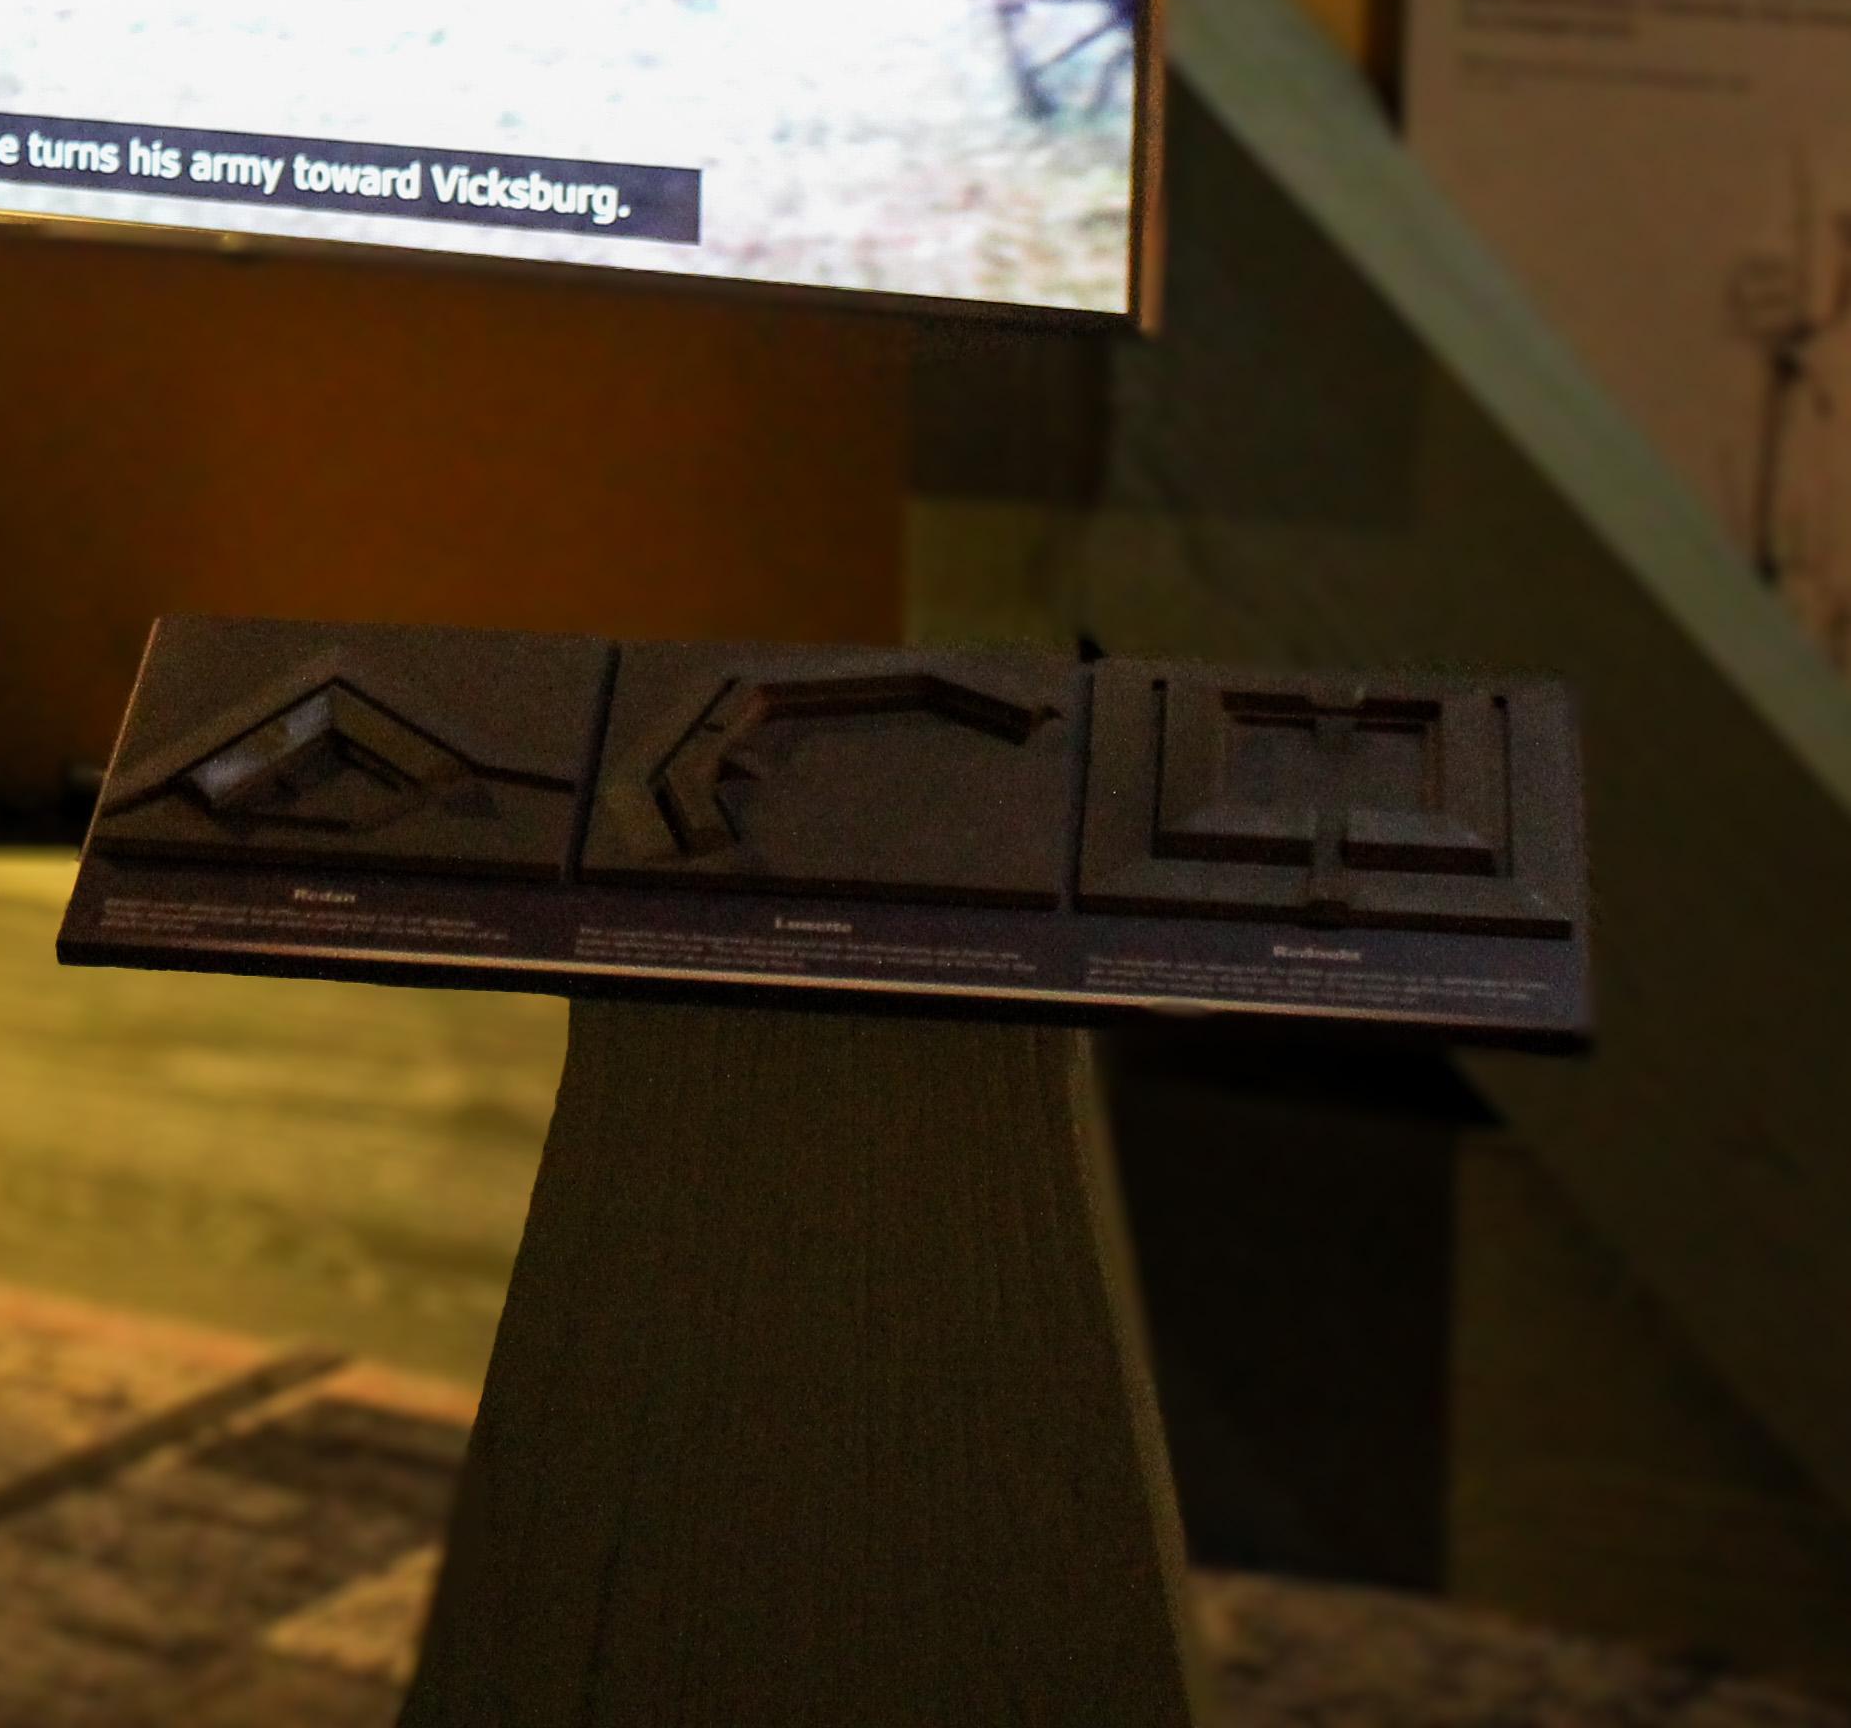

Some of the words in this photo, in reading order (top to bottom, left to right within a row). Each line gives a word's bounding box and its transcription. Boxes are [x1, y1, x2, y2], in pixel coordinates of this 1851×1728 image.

[27, 131, 120, 174] turns
[129, 137, 182, 180] his
[189, 149, 285, 196] army
[292, 153, 422, 201] toward
[431, 163, 631, 226] Vicksburg.
[294, 888, 358, 904] Redan
